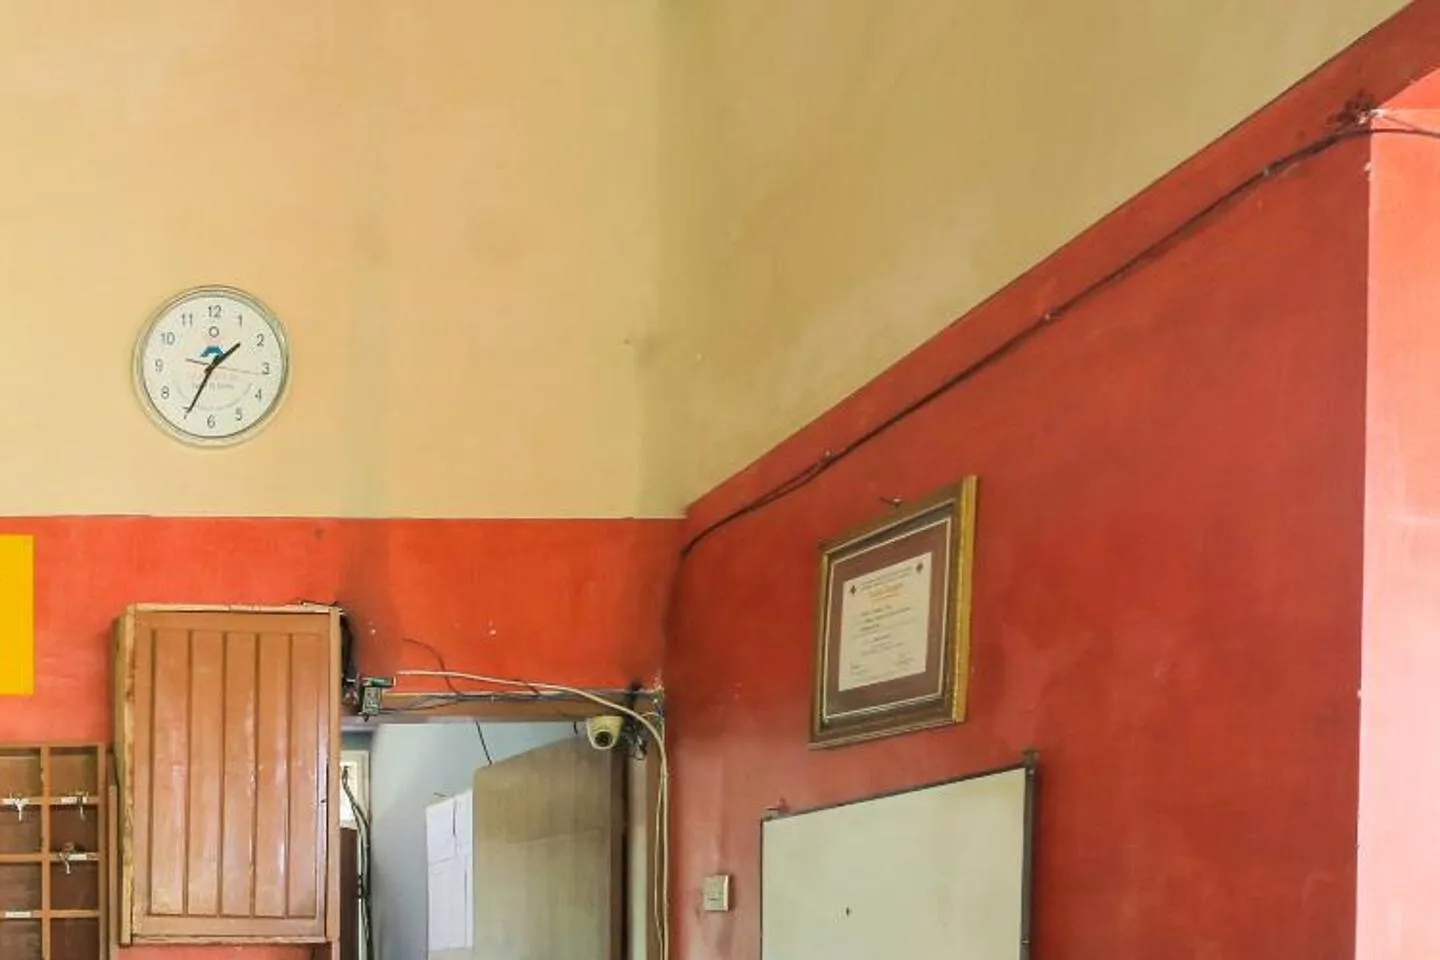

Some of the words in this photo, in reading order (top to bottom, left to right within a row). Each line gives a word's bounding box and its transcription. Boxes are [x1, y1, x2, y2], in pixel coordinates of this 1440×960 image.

[208, 305, 222, 318] 12
[181, 314, 193, 327] 11
[161, 332, 176, 345] 10
[256, 333, 265, 347] 2
[154, 359, 163, 372] 9
[261, 362, 270, 375] 3
[161, 386, 170, 399] 8
[254, 389, 262, 401] 4
[235, 408, 243, 421] 5
[207, 415, 216, 428] 6
